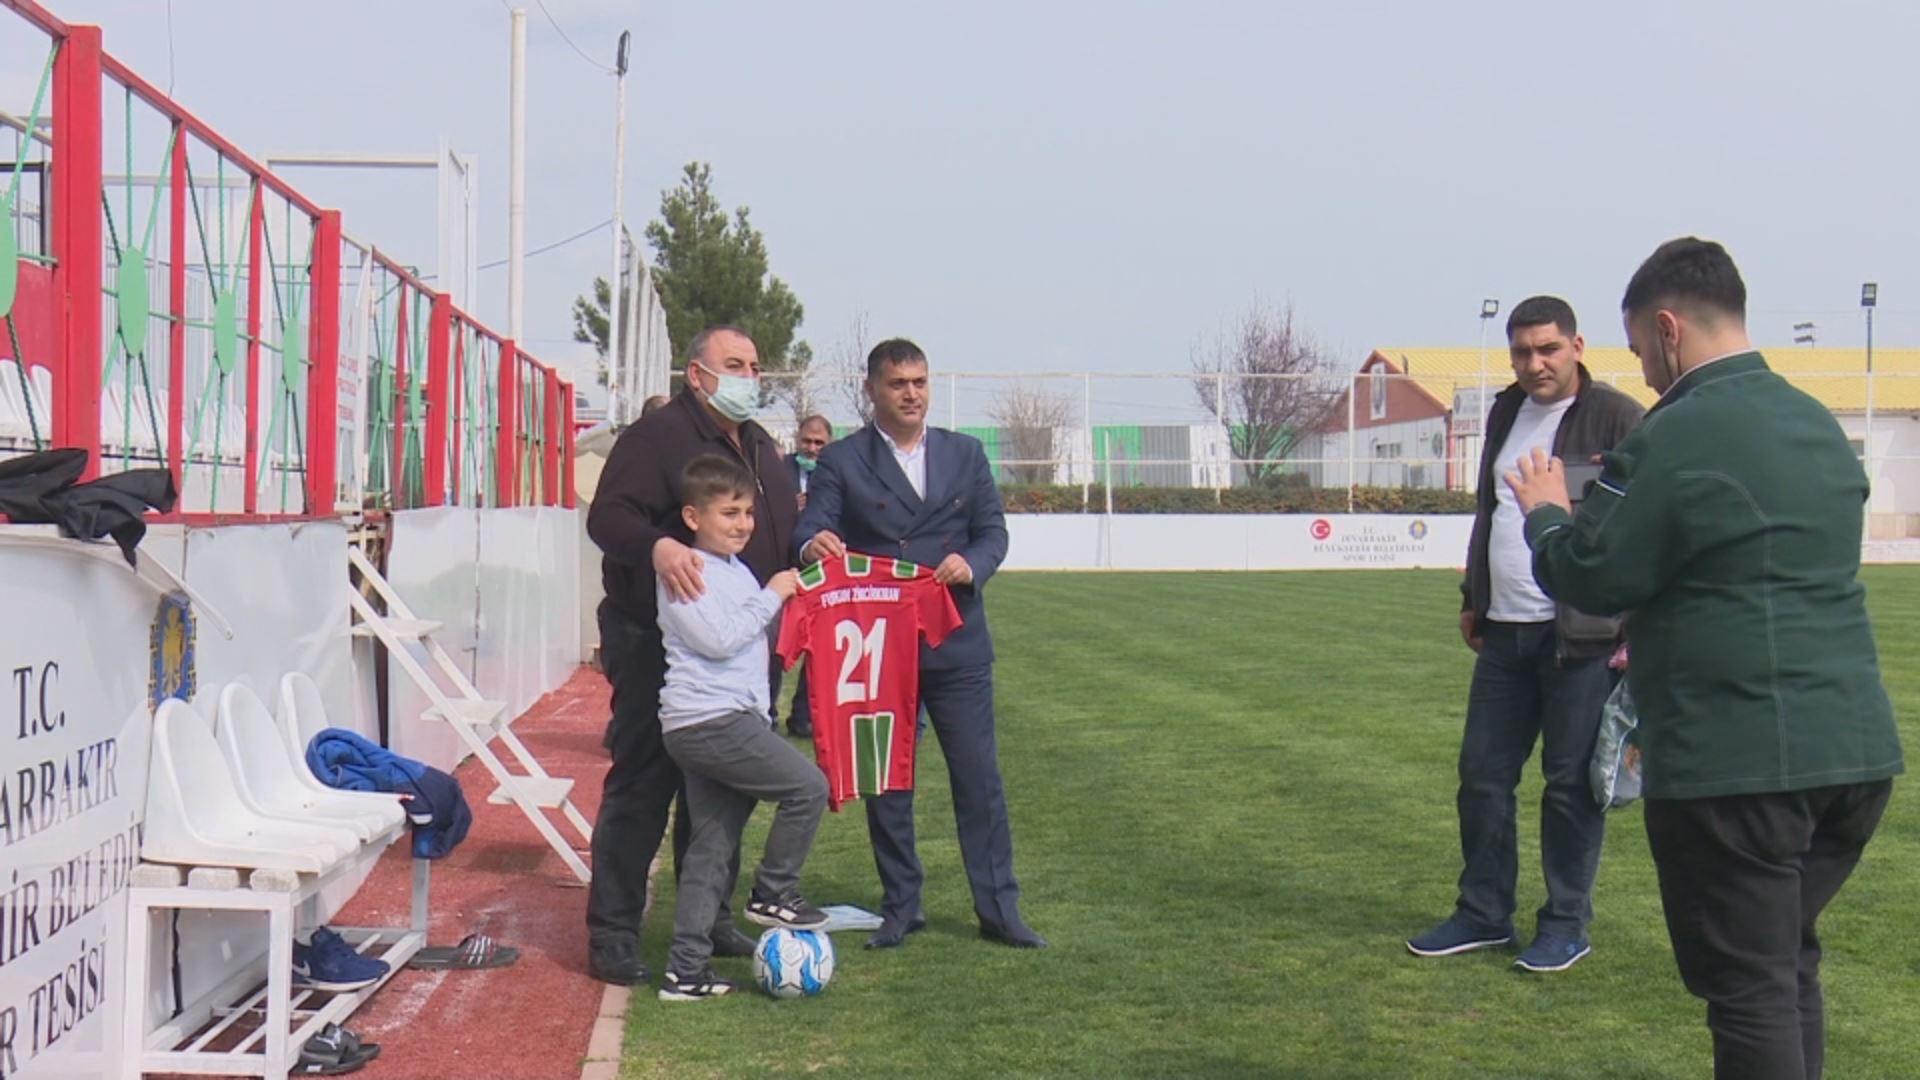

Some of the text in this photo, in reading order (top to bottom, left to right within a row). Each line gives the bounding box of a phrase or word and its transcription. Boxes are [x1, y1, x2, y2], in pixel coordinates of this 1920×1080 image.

[13, 660, 65, 740] T.C.
[835, 617, 887, 706] 21
[28, 923, 107, 1059] TESİSİ
